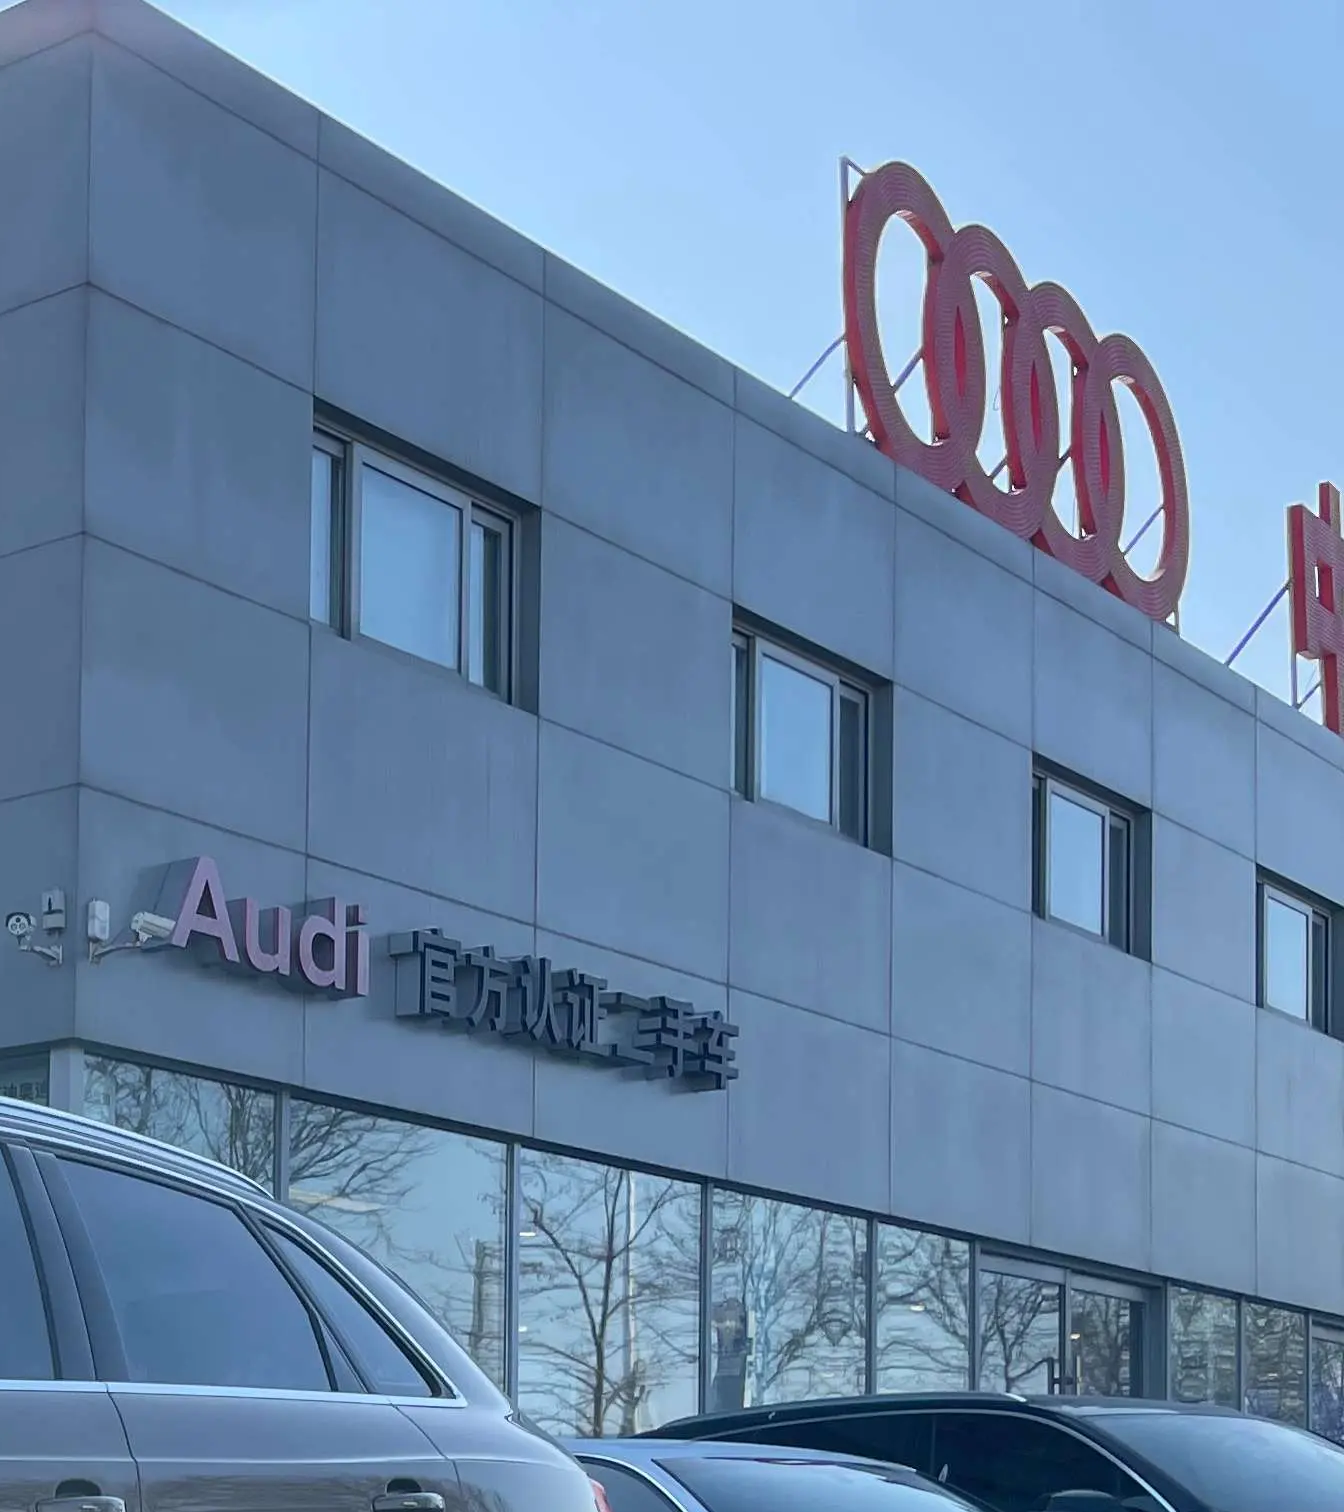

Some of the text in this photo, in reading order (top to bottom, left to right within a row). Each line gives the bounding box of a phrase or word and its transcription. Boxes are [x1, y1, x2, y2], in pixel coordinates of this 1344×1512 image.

[170, 855, 739, 1089] Audi 官方认证二手车
